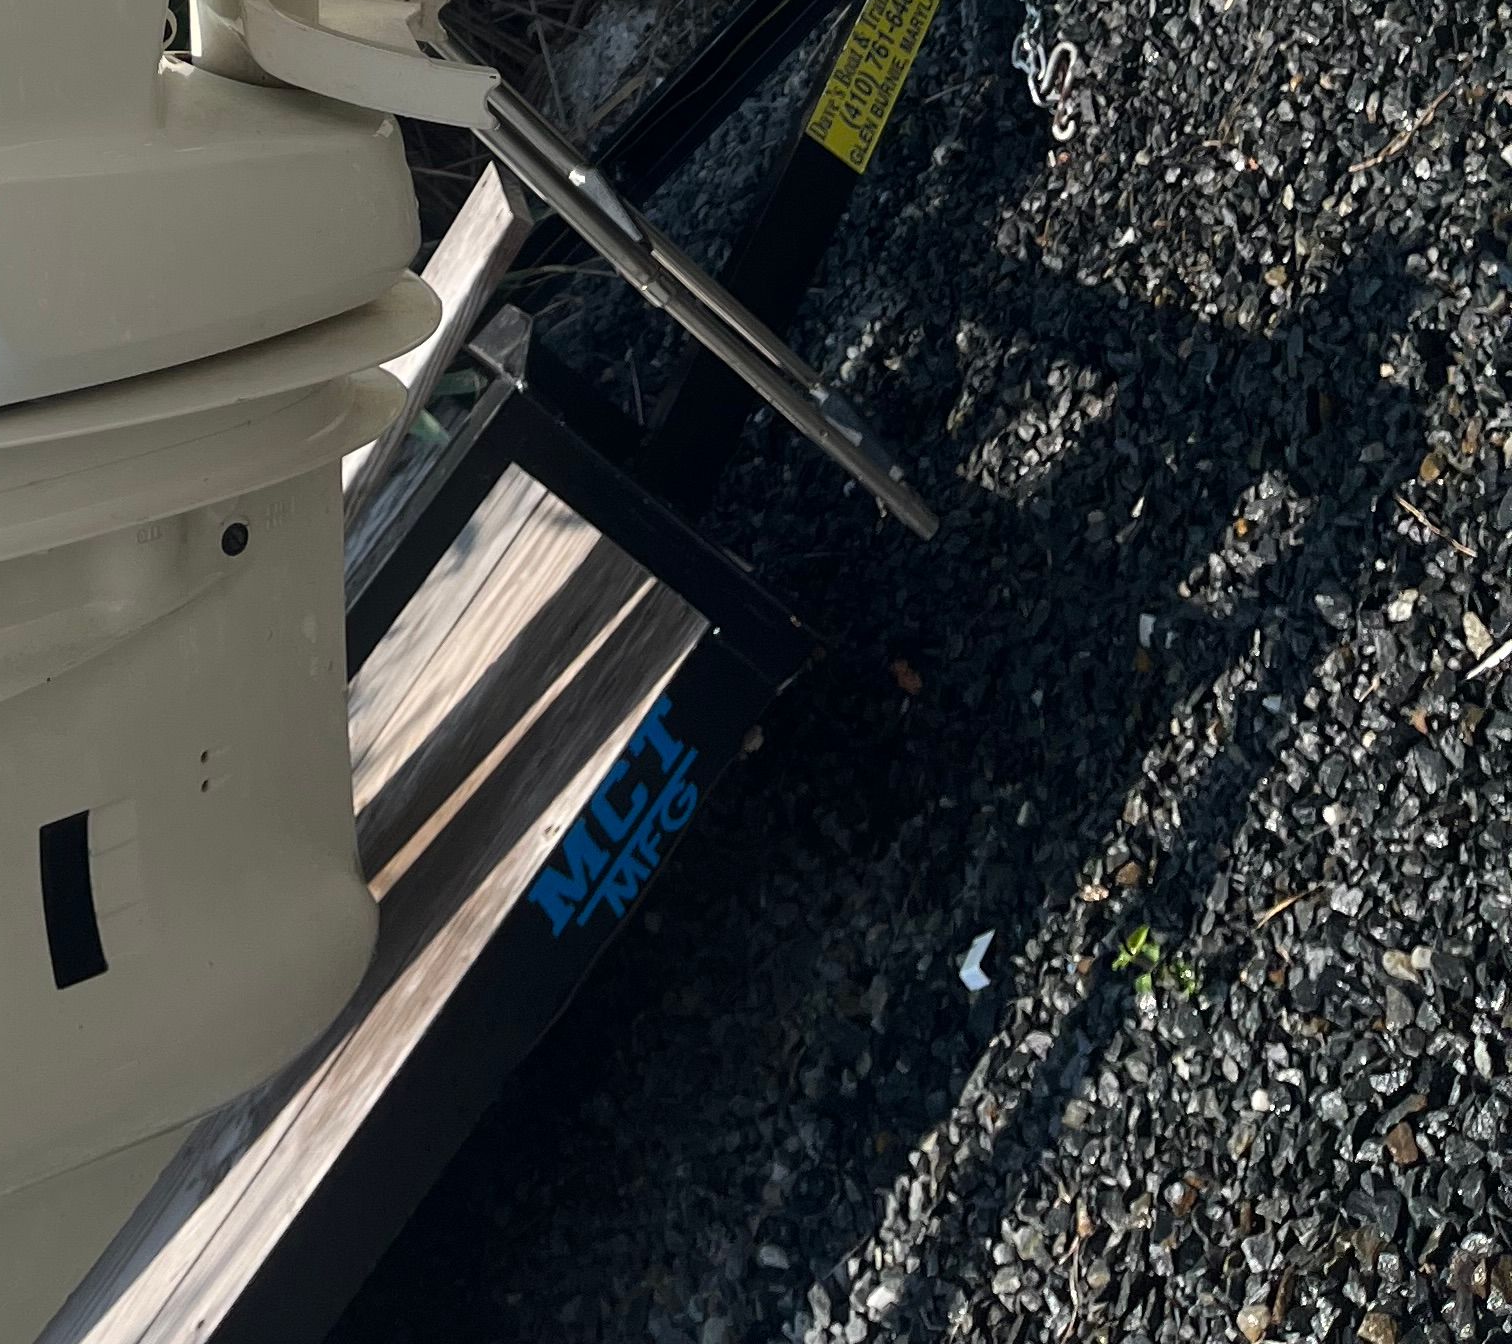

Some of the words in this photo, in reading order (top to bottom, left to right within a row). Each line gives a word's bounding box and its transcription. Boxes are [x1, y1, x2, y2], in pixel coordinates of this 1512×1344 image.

[807, 83, 845, 141] Dave's
[832, 44, 863, 87] Boat
[836, 68, 879, 132] (410)
[847, 117, 878, 167] GLEN
[528, 692, 685, 939] MCT
[596, 779, 698, 919] MFG
